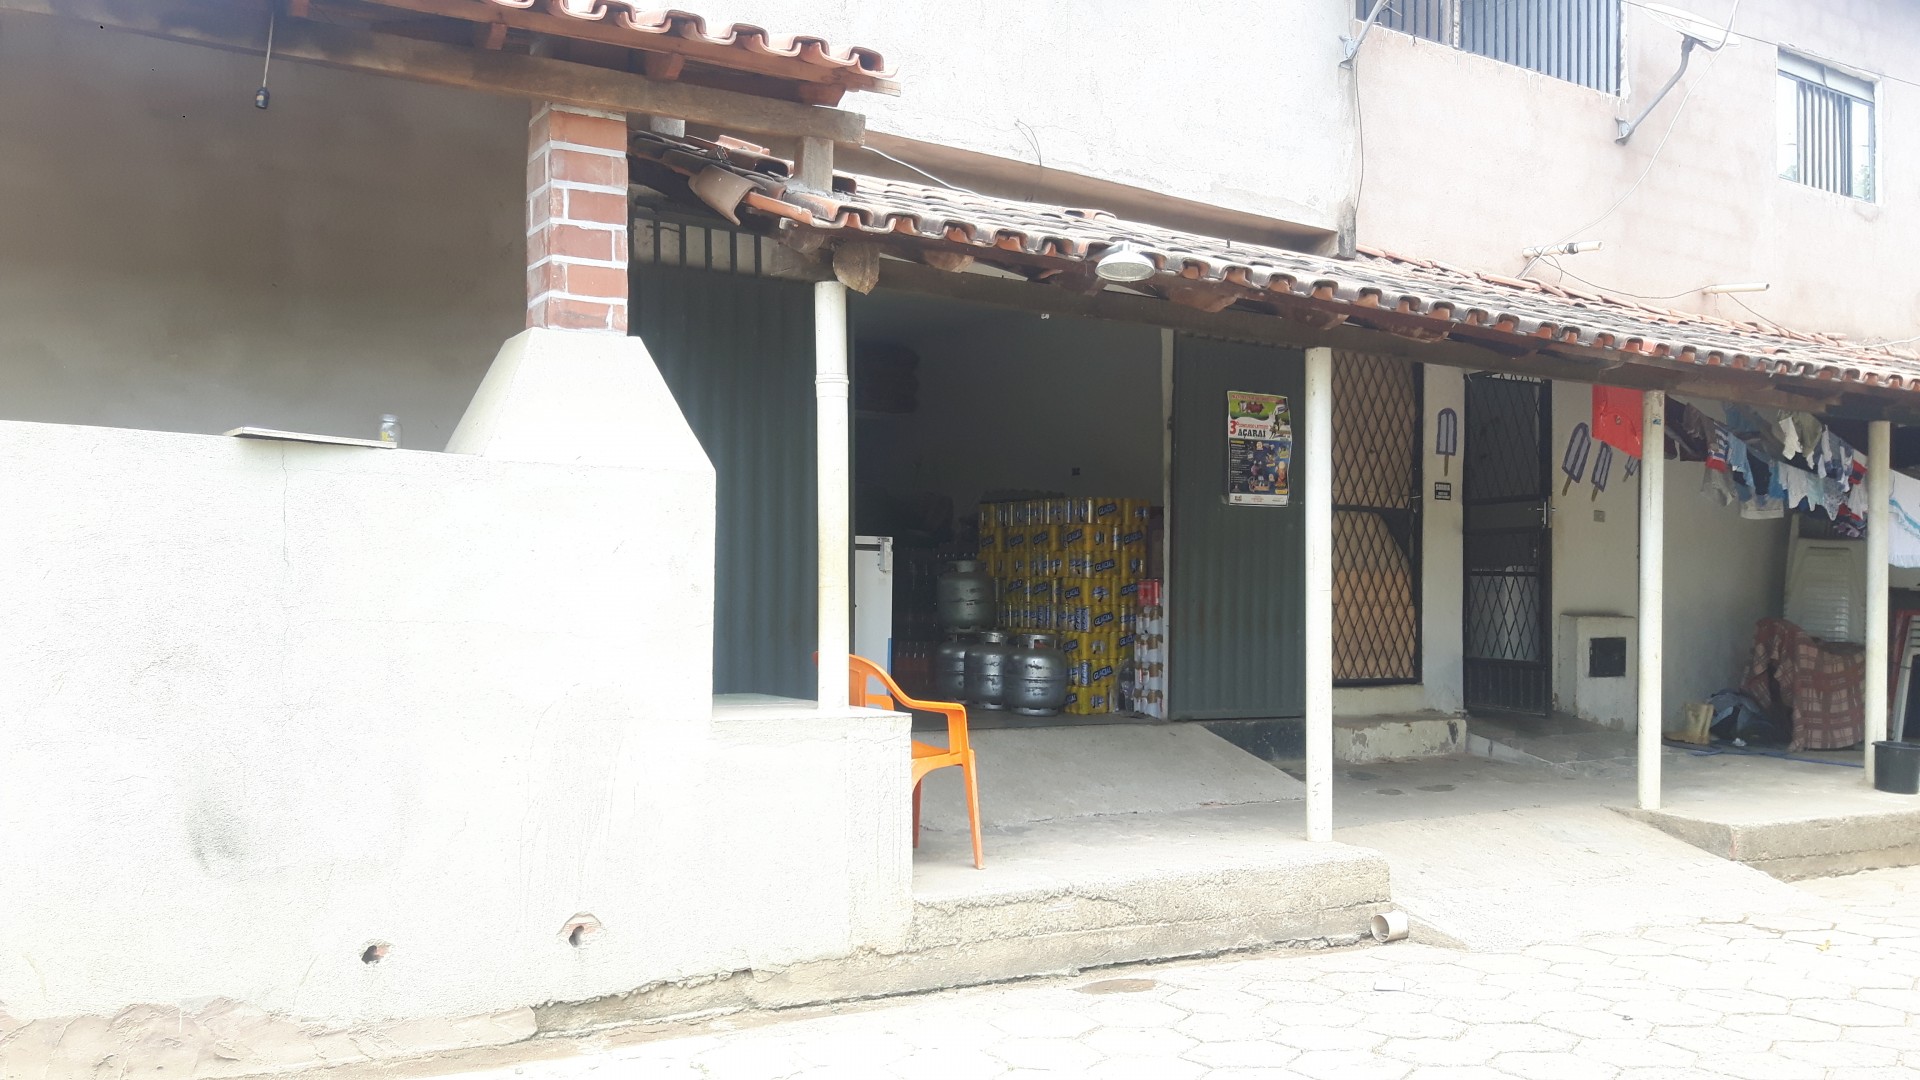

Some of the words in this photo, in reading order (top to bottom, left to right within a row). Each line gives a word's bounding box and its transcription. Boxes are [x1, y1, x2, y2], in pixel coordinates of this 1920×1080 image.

[1095, 560, 1114, 571] GLACIAL
[1094, 612, 1113, 625] GLACIAL
[1093, 666, 1112, 680] GLACIAL
